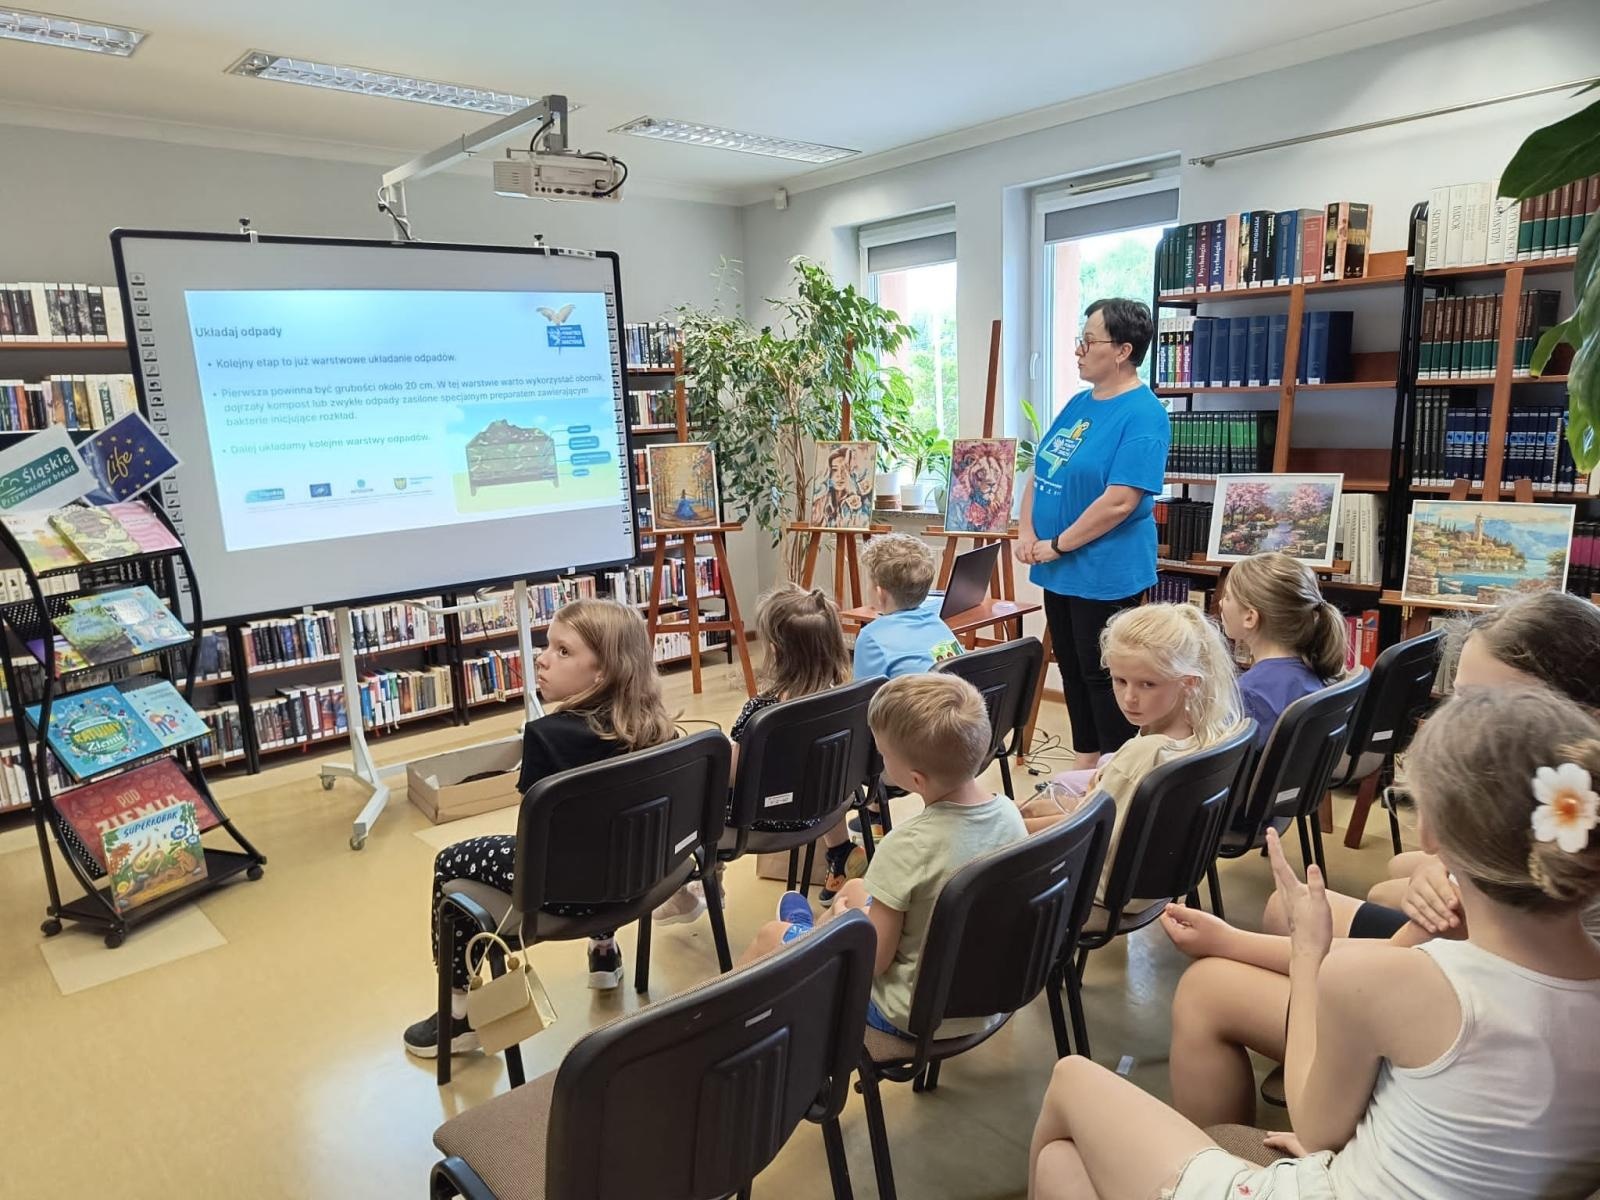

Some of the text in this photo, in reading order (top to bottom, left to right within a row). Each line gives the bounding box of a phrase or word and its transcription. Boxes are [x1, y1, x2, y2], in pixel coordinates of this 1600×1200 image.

[195, 327, 282, 339] Układaj odpady
[216, 359, 253, 369] Kolejny
[256, 358, 279, 368] etap
[282, 357, 292, 367] to
[294, 356, 309, 368] już
[311, 356, 366, 366] warstwowe
[221, 388, 269, 399] Pierwsza
[270, 386, 313, 398] powinna
[314, 385, 332, 395] być
[405, 381, 417, 390] 20
[437, 380, 446, 389] W
[448, 379, 460, 390] tej
[461, 379, 499, 388] warstwie
[501, 378, 524, 387] warto
[267, 399, 310, 411] kompost
[312, 398, 328, 409] lub
[365, 396, 400, 406] odpady
[402, 394, 438, 405] zasilone
[440, 391, 488, 403] specjalnym
[489, 389, 536, 401] preparatem
[346, 436, 385, 446] warstwy
[22, 453, 71, 484] Śląskie
[107, 446, 133, 485] Life
[117, 789, 140, 808] POD
